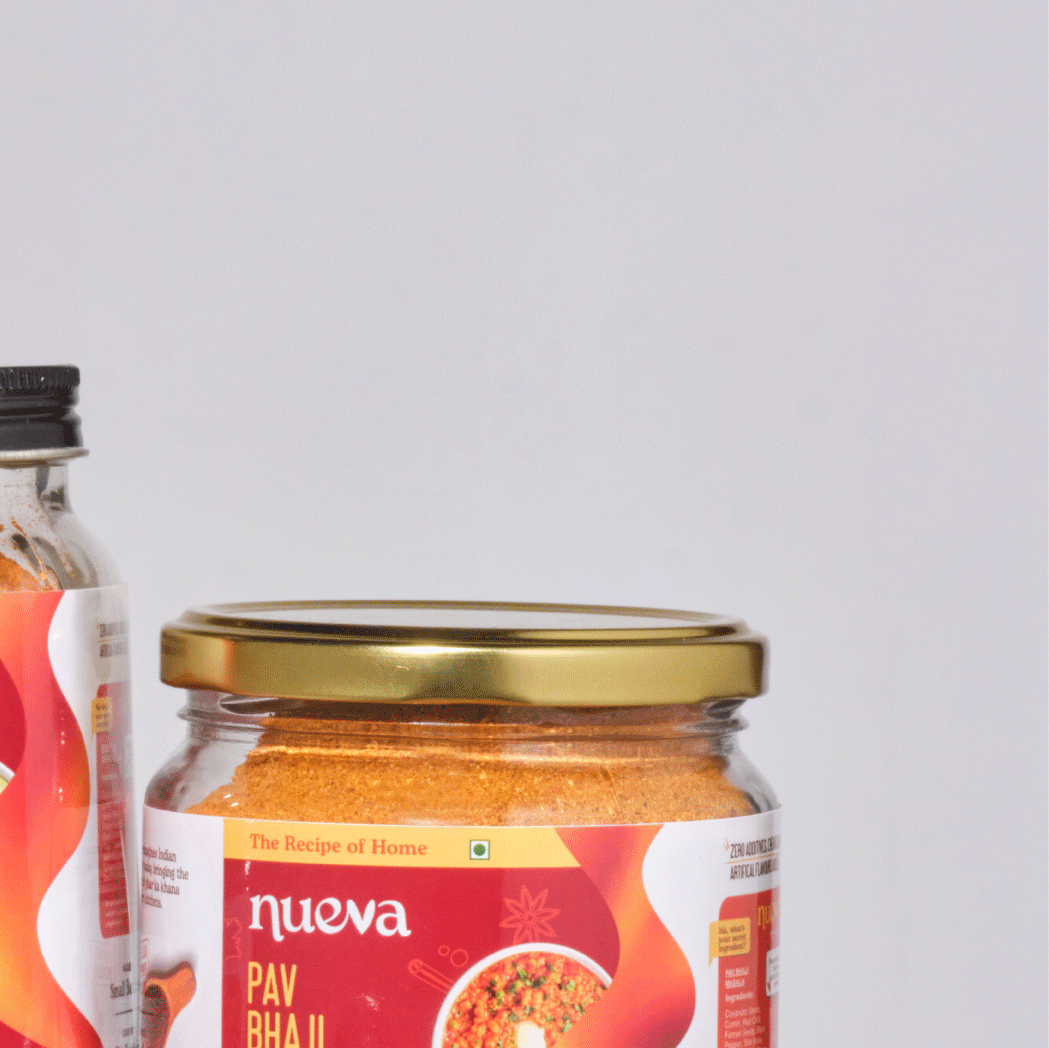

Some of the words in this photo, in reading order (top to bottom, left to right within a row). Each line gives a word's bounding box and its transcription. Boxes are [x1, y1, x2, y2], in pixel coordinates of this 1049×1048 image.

[250, 834, 278, 851] The
[282, 836, 341, 859] Recipe
[347, 838, 367, 854] of
[371, 839, 428, 856] Home
[730, 842, 745, 858] ZERO
[176, 867, 189, 880] the
[248, 894, 412, 942] nueva
[247, 961, 297, 1007] PAV
